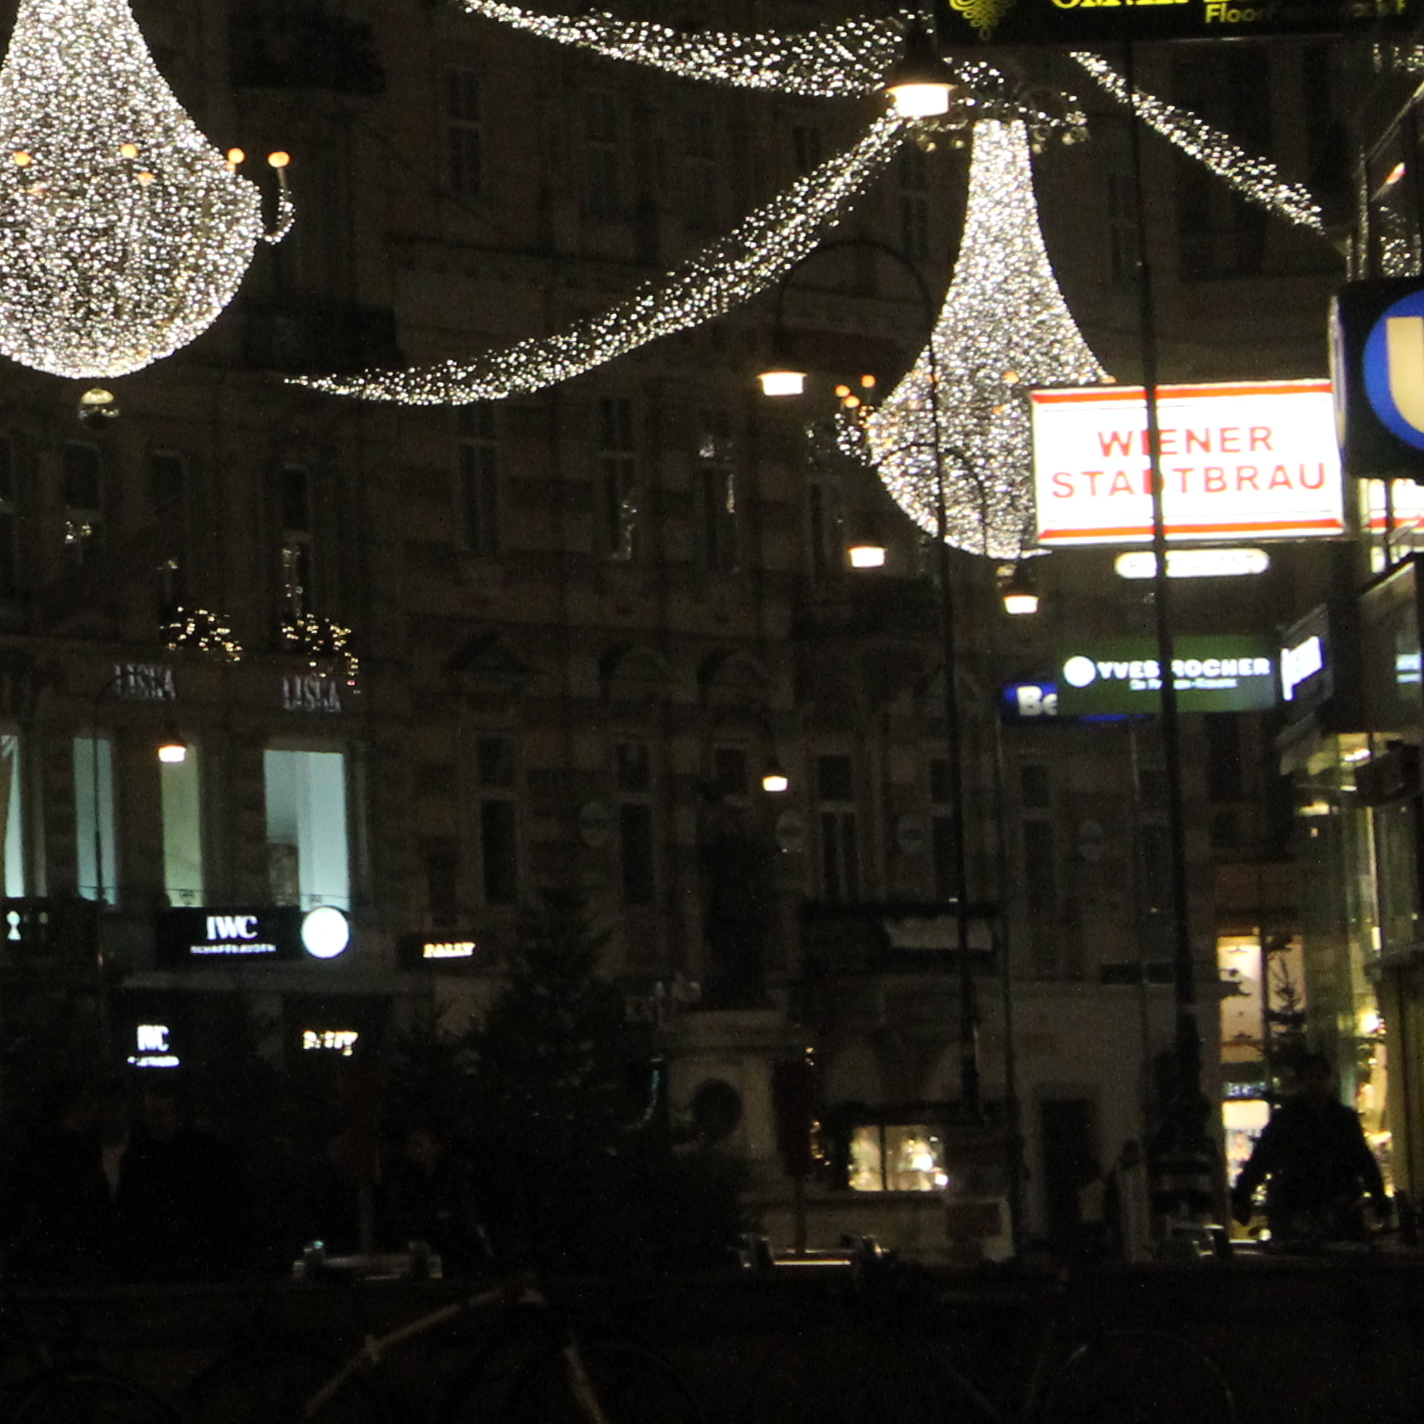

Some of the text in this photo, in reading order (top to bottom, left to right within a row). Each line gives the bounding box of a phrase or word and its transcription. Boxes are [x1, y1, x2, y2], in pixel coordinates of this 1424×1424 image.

[1097, 426, 1274, 459] WIENER
[1097, 658, 1272, 679] YVES ROCHER
[205, 915, 259, 941] IWC
